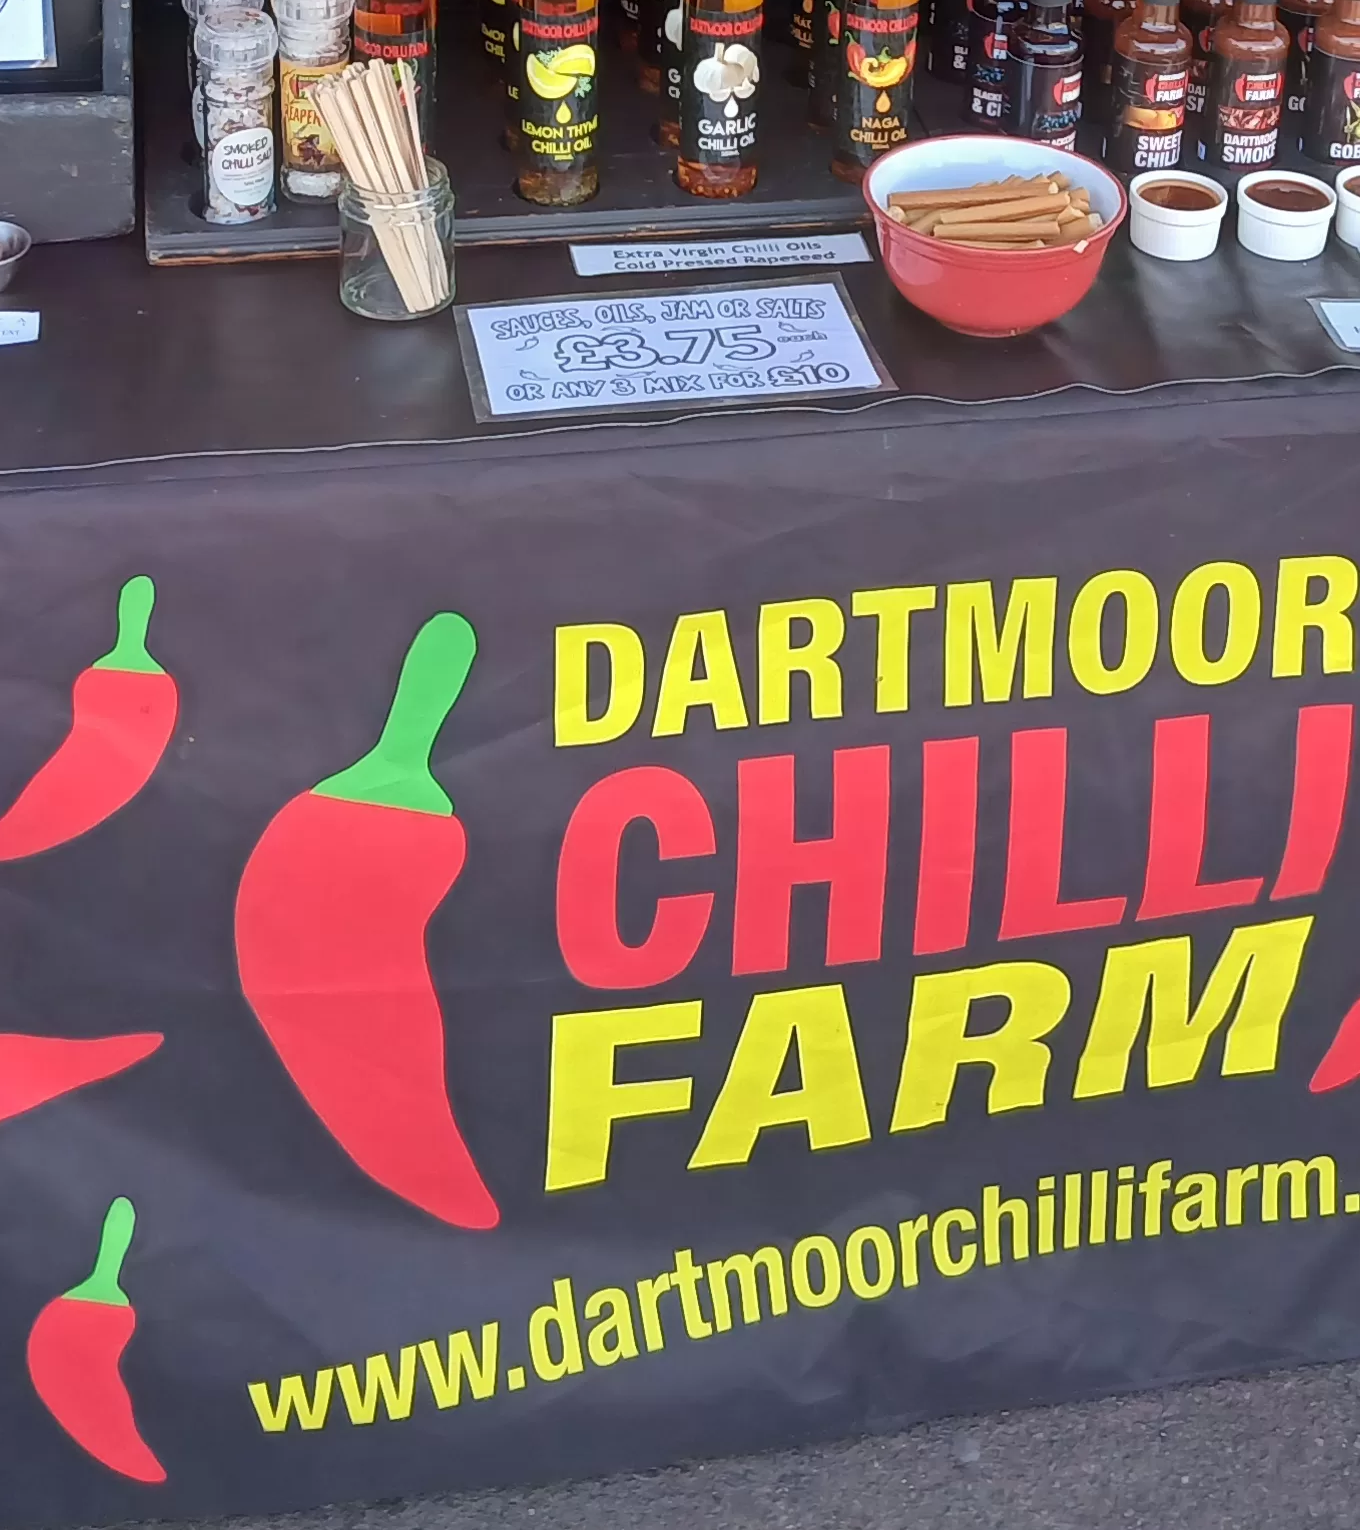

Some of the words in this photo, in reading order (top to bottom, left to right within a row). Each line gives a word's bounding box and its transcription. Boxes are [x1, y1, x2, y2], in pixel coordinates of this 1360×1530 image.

[1156, 89, 1183, 101] FARM
[1246, 90, 1275, 101] FARM
[522, 119, 563, 138] LEMON
[698, 113, 756, 136] GARLIC
[862, 117, 899, 128] NAGA
[532, 141, 571, 153] CHILLI
[574, 137, 592, 152] OIL
[698, 137, 737, 151] CHILLI
[741, 132, 755, 147] OIL
[851, 129, 888, 143] CHILLI
[891, 128, 907, 142] OIL
[224, 136, 268, 156] SMOKED
[222, 155, 253, 170] CHILLI
[613, 250, 663, 259] Extra
[669, 246, 725, 258] Virgin
[732, 243, 779, 254] Chilli
[786, 242, 821, 250] Oils
[615, 260, 656, 270] Cold
[664, 257, 737, 268] Pressed
[744, 252, 836, 265] Rapeseed
[491, 308, 592, 339] SAUCES,
[596, 303, 656, 323] OILS,
[661, 300, 713, 320] JAM
[718, 300, 750, 318] OR
[756, 298, 826, 318] SALTS
[554, 325, 776, 372] £3.75
[506, 382, 545, 401] OR
[552, 379, 607, 398] ANY
[610, 377, 636, 396] 3
[644, 374, 704, 395] MIX
[709, 371, 764, 390] FOR
[766, 362, 849, 388] £10
[554, 555, 1360, 748] DARTMOOR
[556, 703, 1353, 990] CHILLI
[544, 914, 1315, 1192] FARM
